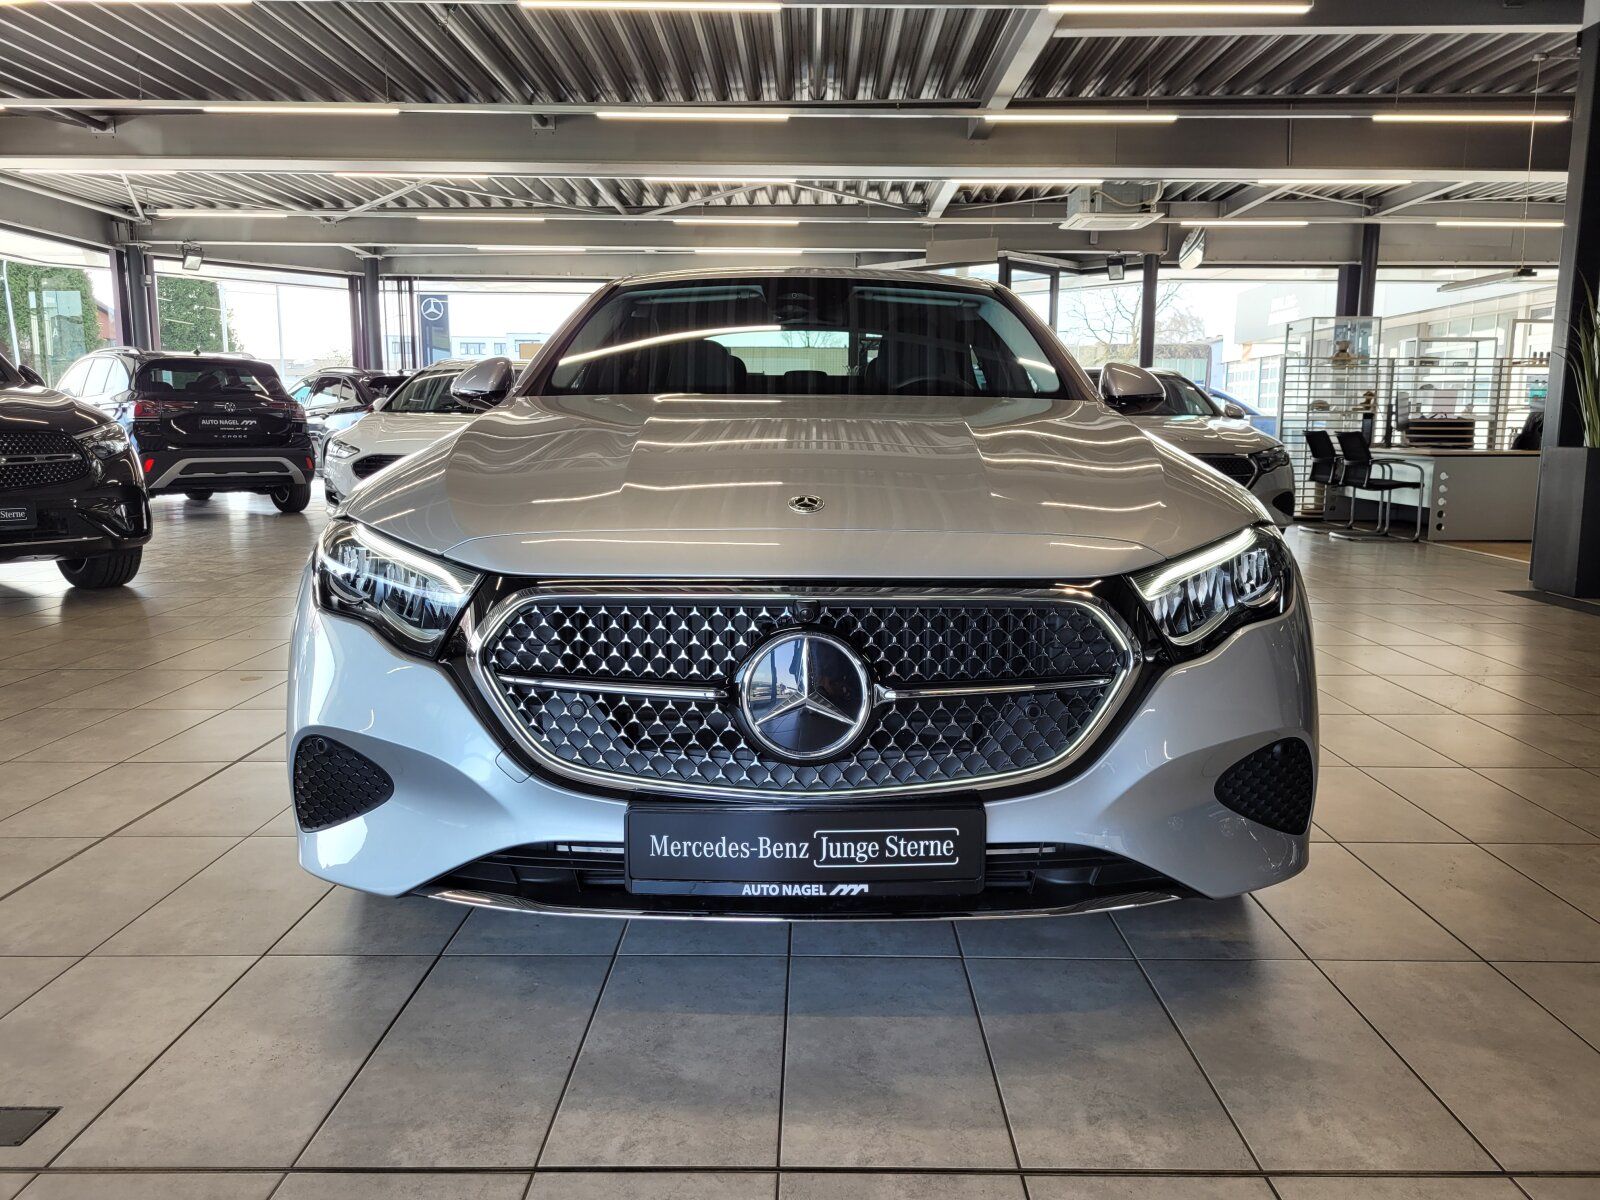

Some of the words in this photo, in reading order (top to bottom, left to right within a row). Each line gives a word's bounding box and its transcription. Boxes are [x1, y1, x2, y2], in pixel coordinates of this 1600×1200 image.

[0, 510, 26, 519] Sterne
[649, 834, 810, 859] Mercedes-Benz
[819, 836, 880, 863] Junge
[885, 835, 954, 858] Sterne
[741, 884, 780, 896] AUTO
[782, 884, 827, 896] NAGEL
